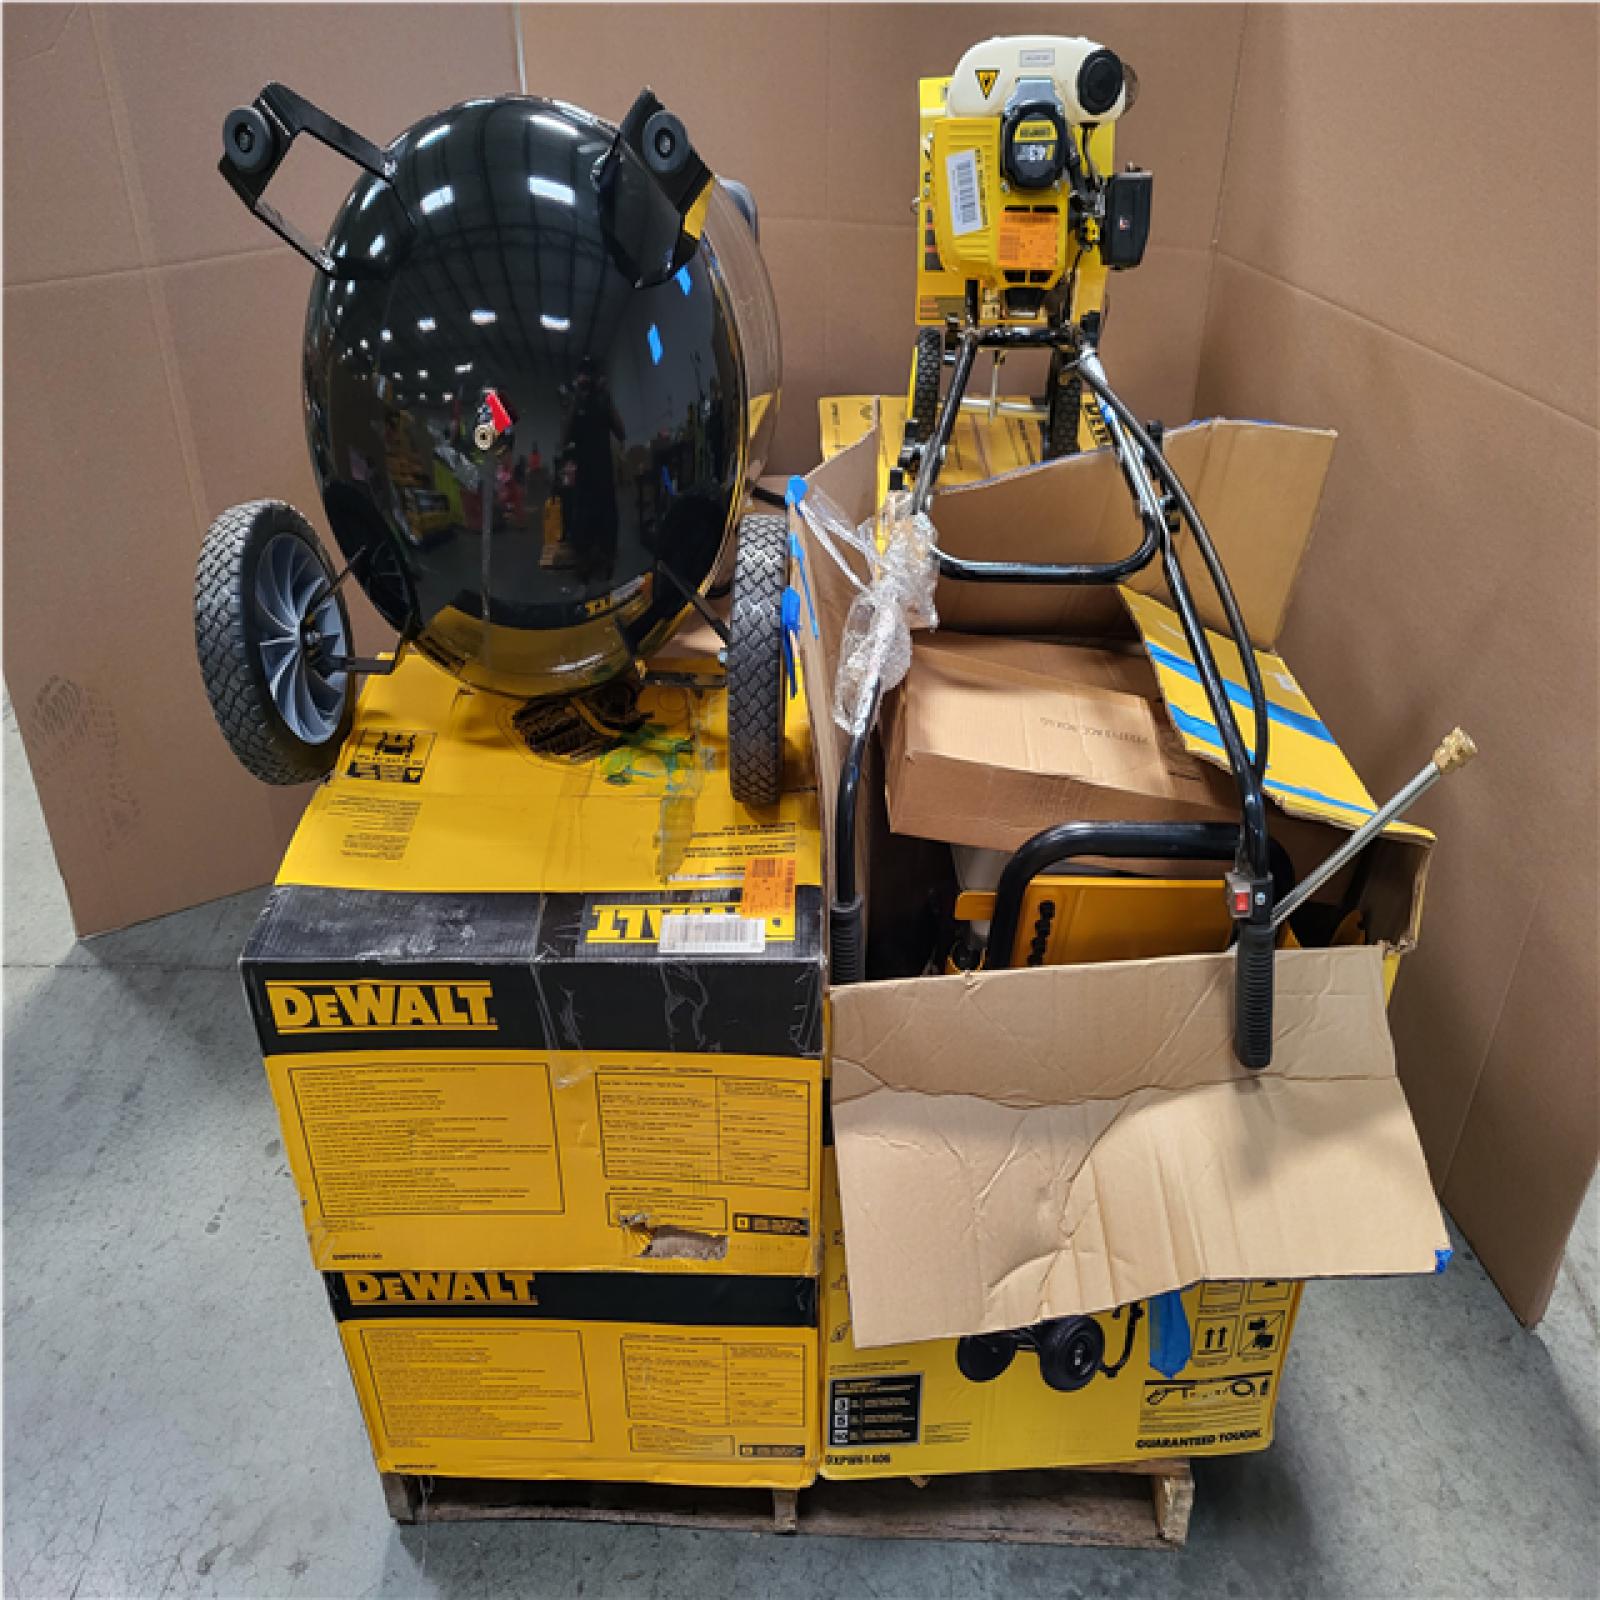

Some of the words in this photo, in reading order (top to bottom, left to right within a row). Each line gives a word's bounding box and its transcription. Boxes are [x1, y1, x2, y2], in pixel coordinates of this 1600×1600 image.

[267, 984, 493, 1027] DEWALT
[344, 1271, 535, 1302] DEWALT
[1135, 1434, 1216, 1449] GUARANTEED
